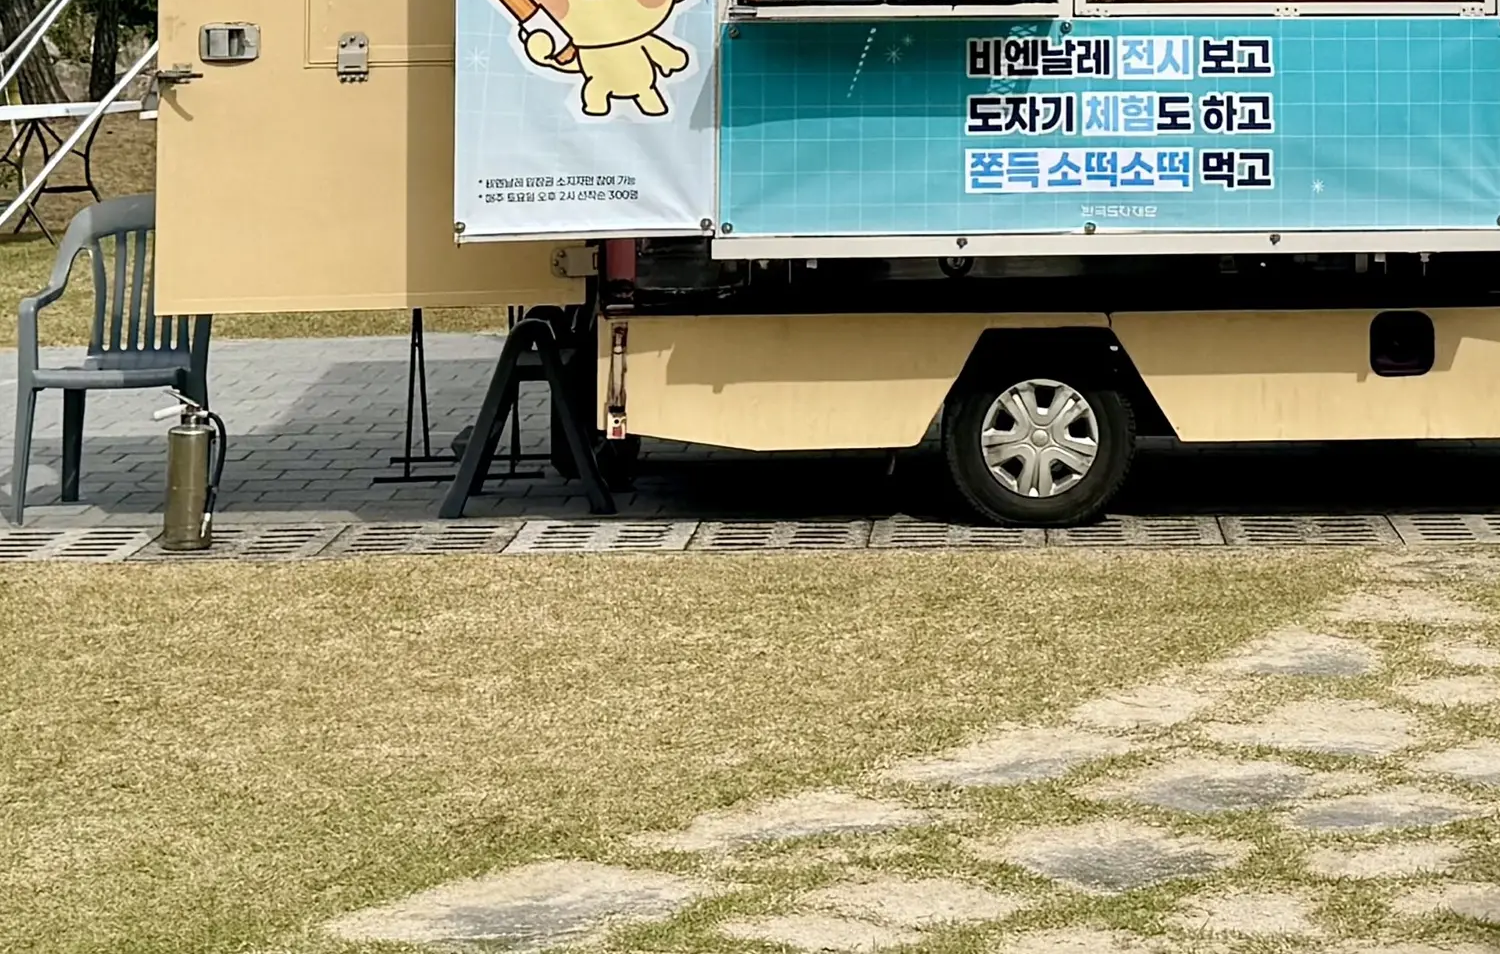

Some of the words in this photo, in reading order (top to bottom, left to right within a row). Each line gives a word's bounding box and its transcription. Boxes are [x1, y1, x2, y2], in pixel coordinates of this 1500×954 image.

[968, 38, 1111, 77] 비엔날레
[1121, 38, 1191, 76] 전시
[1201, 38, 1272, 75] 보고
[967, 95, 1073, 133] 도자기
[1085, 94, 1193, 133] 체험도
[1201, 94, 1272, 133] 하고
[970, 151, 1041, 190] 쫀득
[1048, 151, 1190, 189] 소떡소떡
[1201, 151, 1272, 189] 먹고
